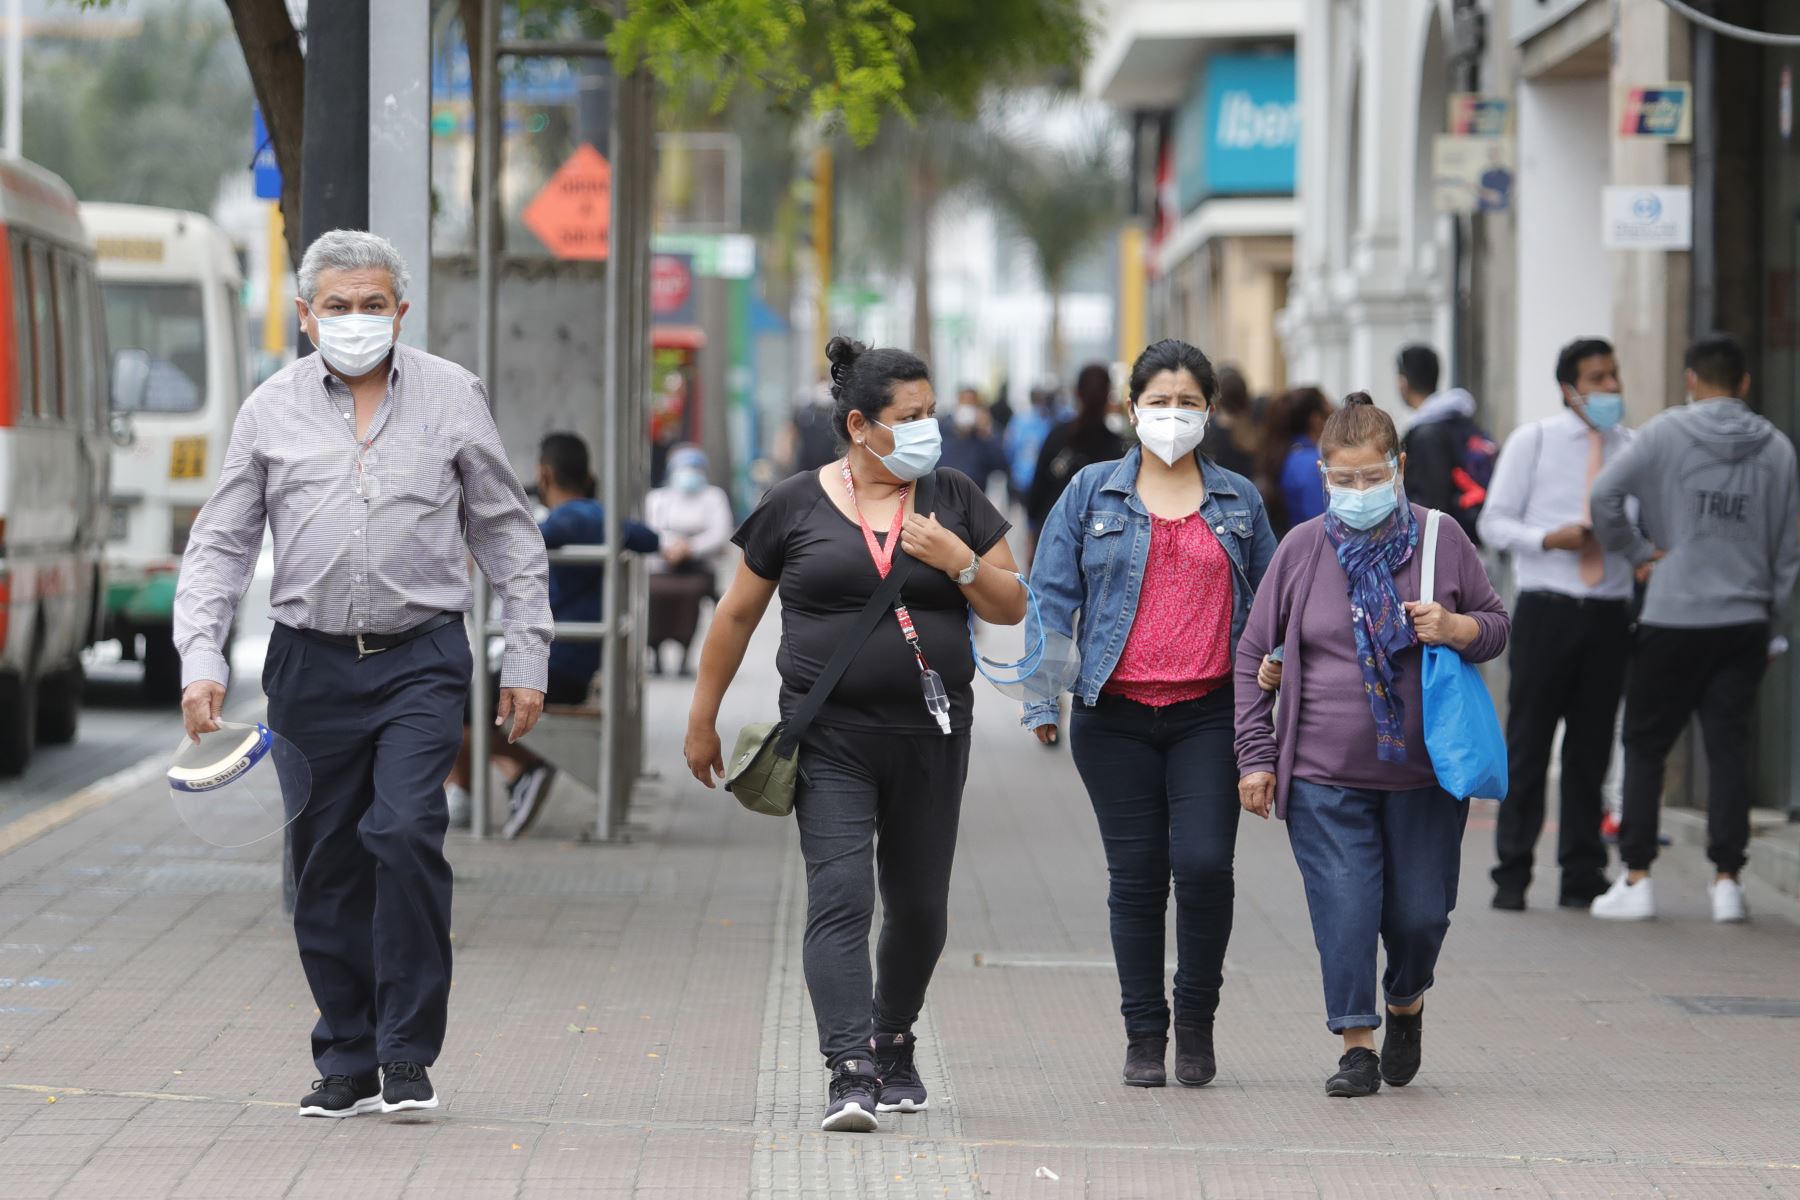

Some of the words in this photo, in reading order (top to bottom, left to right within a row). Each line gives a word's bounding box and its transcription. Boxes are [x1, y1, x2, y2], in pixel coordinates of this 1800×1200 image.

[1697, 490, 1748, 522] TRUE
[190, 780, 213, 788] Face
[215, 760, 247, 783] Shield
